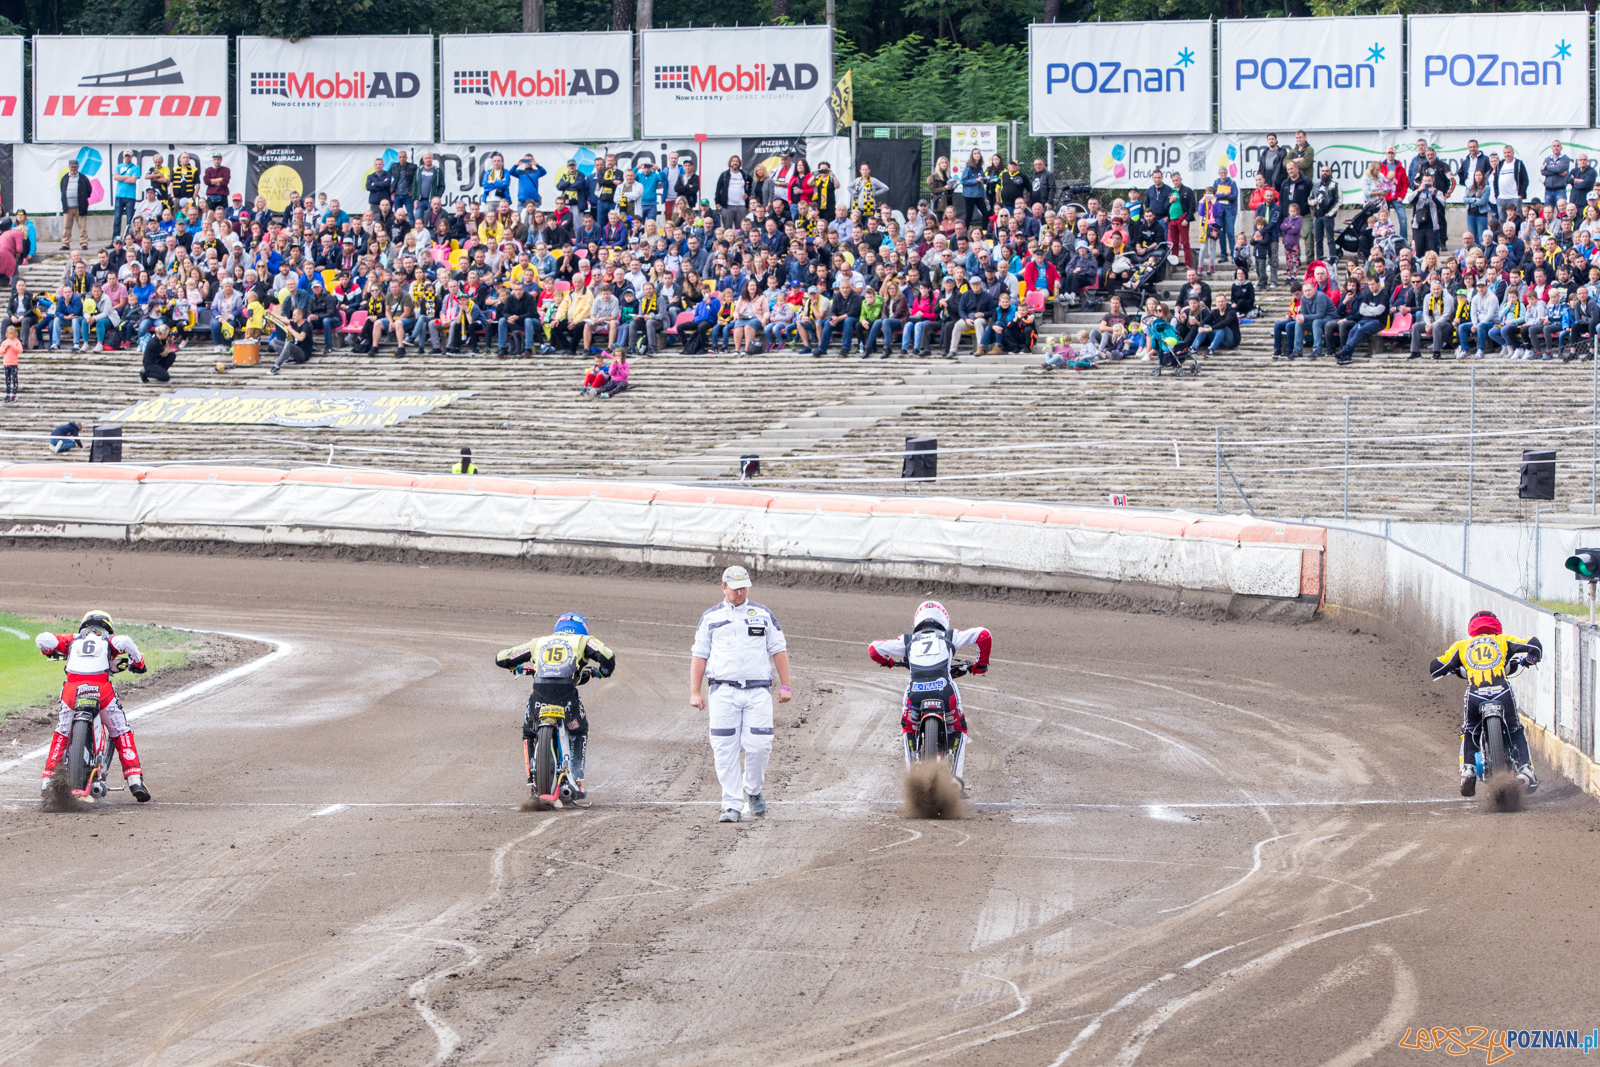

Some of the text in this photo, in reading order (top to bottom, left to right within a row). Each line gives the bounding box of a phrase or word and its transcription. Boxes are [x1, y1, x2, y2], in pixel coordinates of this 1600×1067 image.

[287, 71, 421, 99] Mobil-AD
[490, 68, 620, 97] Mobil-AD
[690, 63, 819, 92] Mobil-AD
[271, 100, 395, 108] Nowoczesny przekaz wizualny
[526, 98, 557, 106] przekaz
[726, 93, 758, 101] przekaz
[761, 92, 795, 100] wizualny
[1134, 142, 1181, 169] mjp
[82, 640, 96, 655] 6
[547, 647, 563, 662] 15
[922, 641, 933, 654] 7
[1475, 646, 1492, 661] 14
